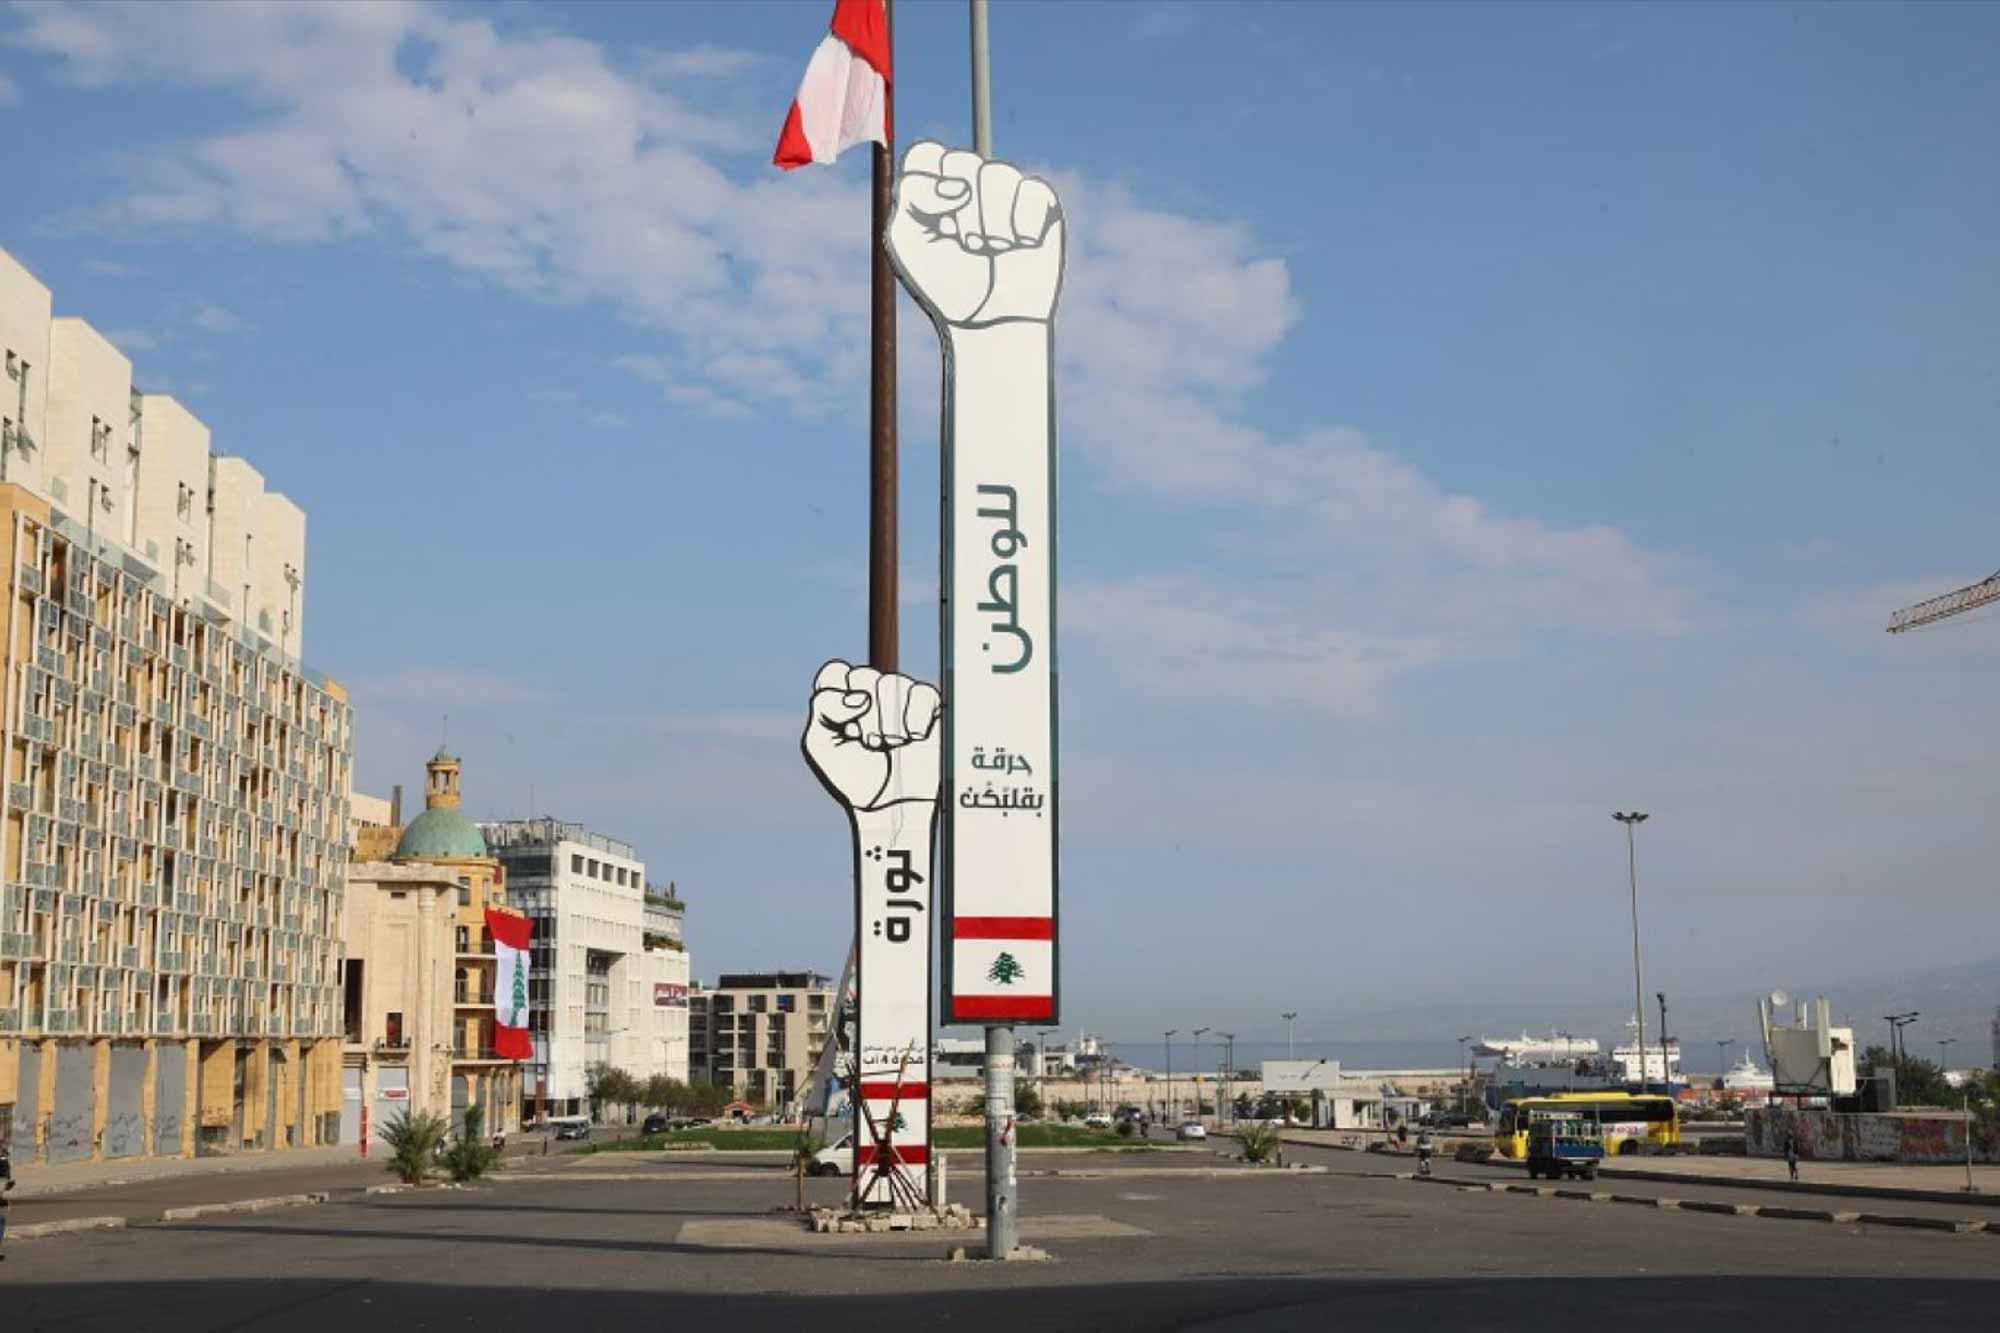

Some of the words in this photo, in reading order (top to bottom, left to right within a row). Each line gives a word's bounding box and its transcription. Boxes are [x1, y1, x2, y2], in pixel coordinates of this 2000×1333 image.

[977, 484, 1033, 674] للوطن
[972, 746, 1032, 775] حرقة
[865, 845, 925, 943] ثورة
